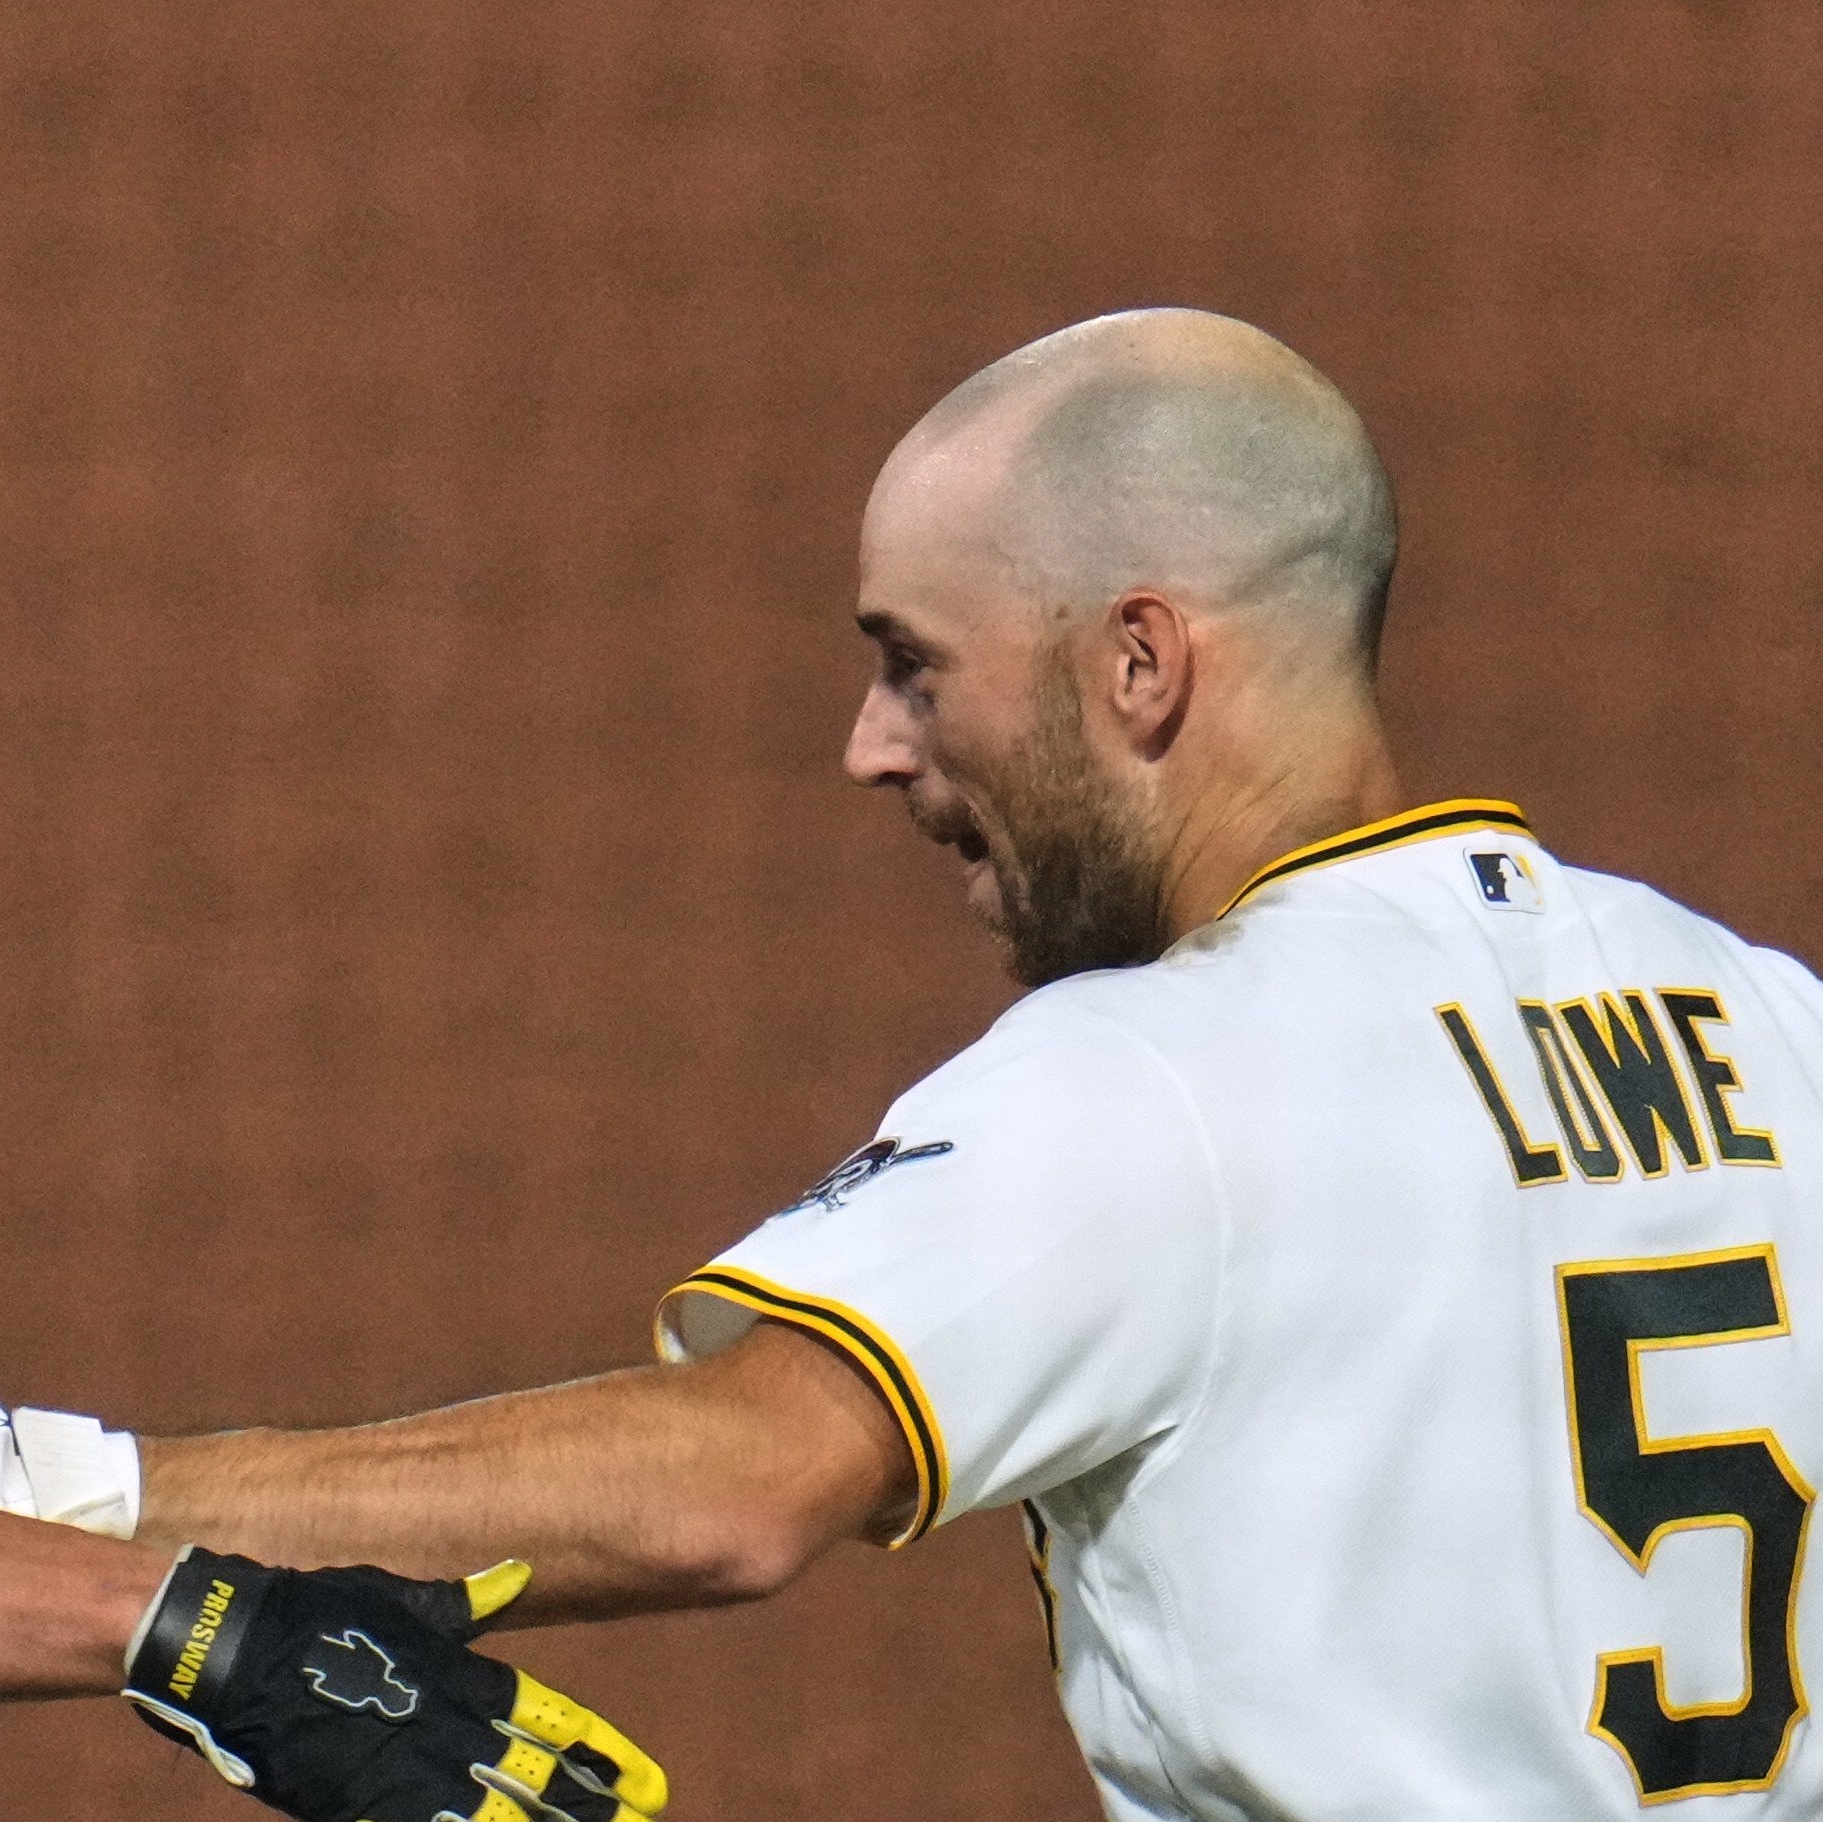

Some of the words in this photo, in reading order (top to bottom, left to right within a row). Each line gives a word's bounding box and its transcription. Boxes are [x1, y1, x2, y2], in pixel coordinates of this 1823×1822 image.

[1434, 986, 1782, 1189] LOWE
[1554, 1242, 1817, 1806] 5
[168, 1579, 235, 1700] PROSWAY
